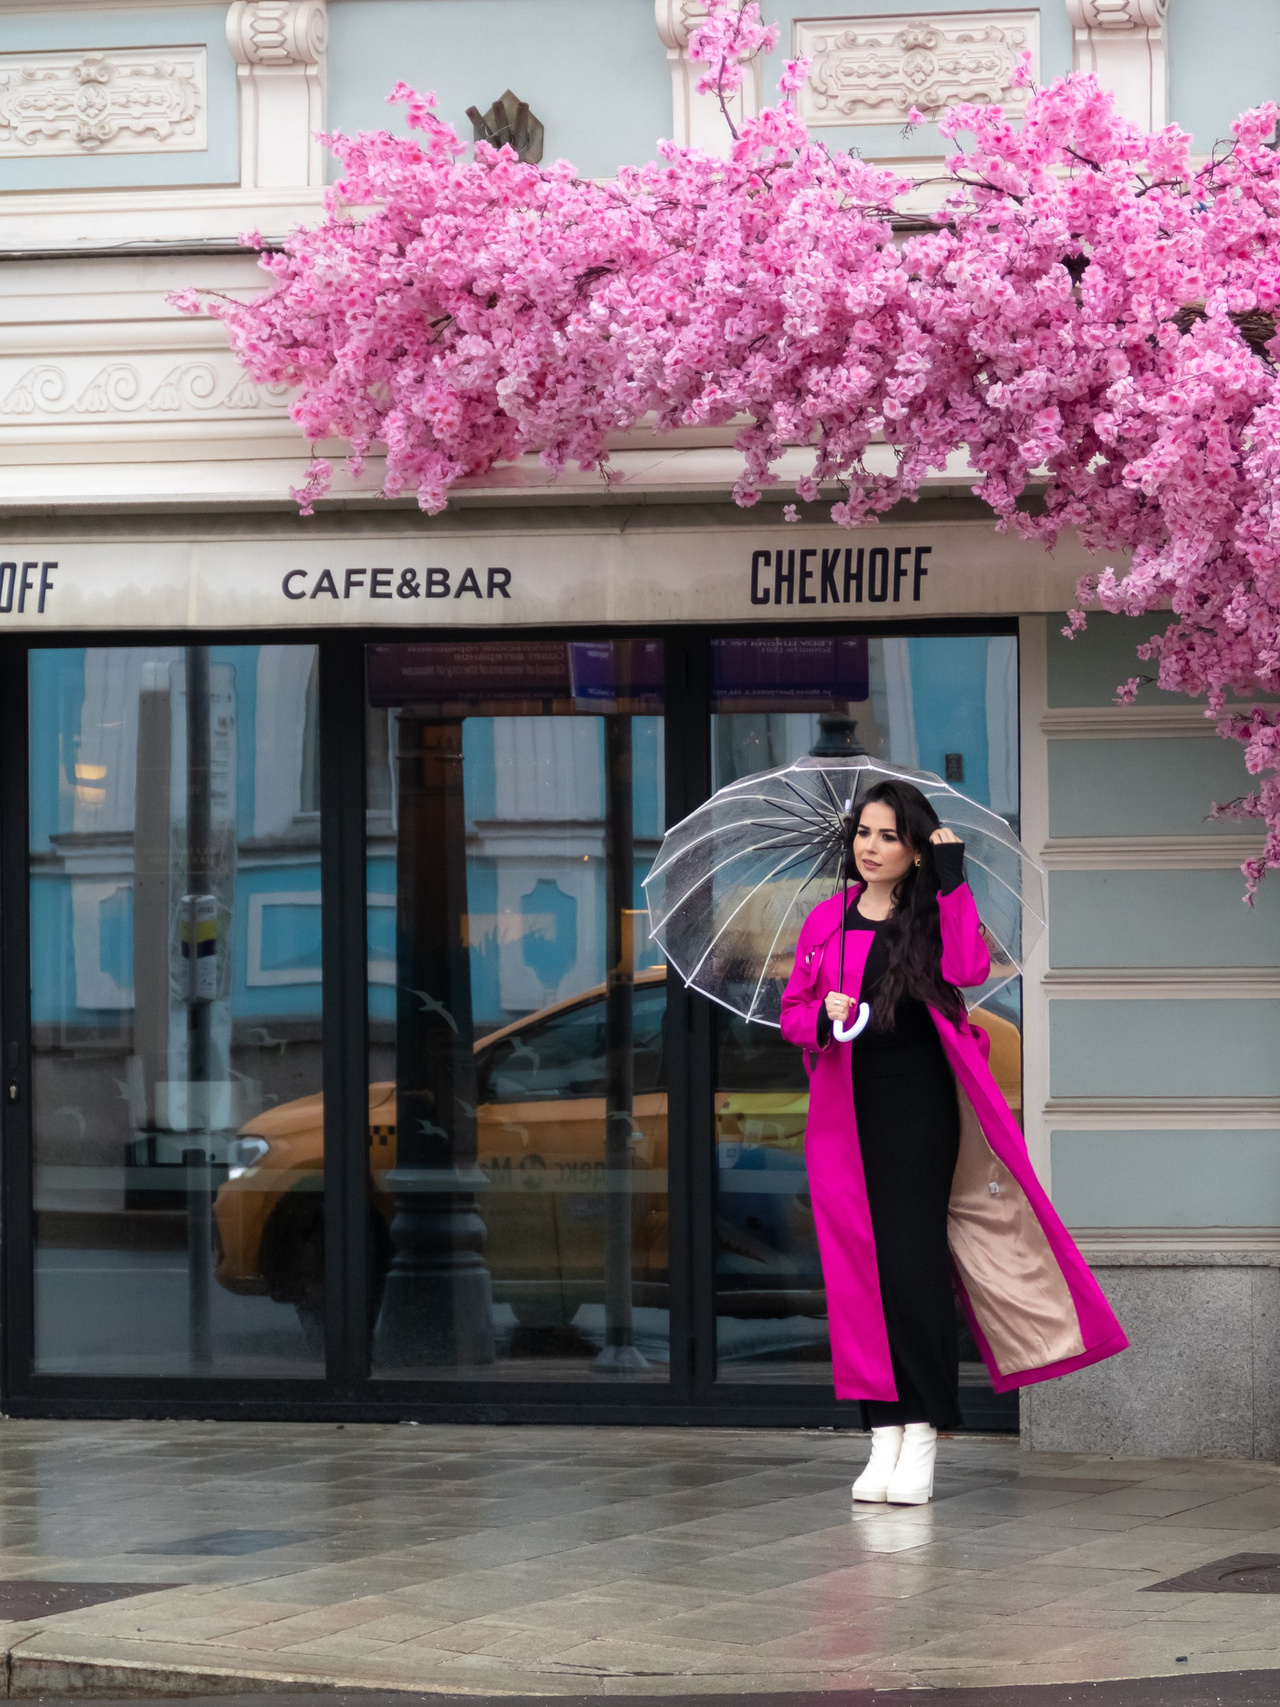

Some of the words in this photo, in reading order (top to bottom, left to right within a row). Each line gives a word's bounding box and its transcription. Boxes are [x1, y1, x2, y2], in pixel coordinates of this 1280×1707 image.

[0, 562, 58, 613] OFF
[282, 567, 512, 600] CAFE&BAR
[751, 546, 932, 605] CHEKHOFF
